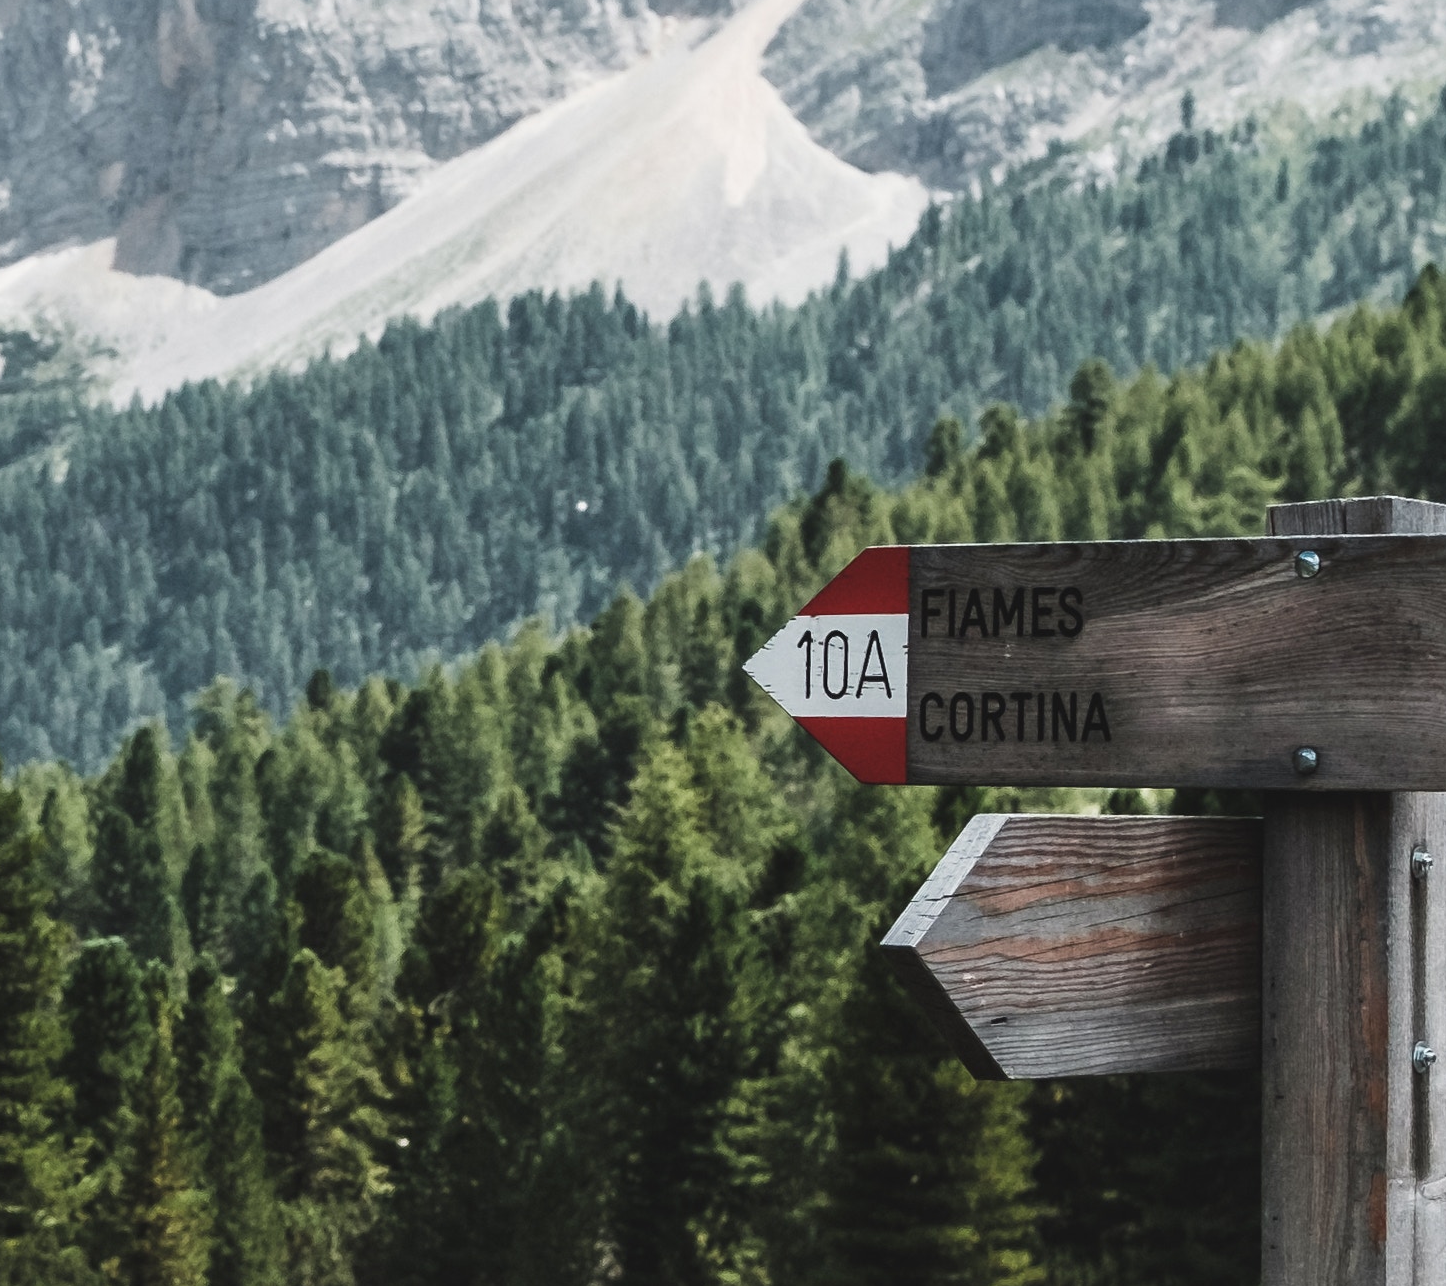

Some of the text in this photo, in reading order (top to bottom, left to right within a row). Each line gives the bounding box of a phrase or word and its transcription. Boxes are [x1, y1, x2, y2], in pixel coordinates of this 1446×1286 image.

[921, 586, 1085, 639] FIAMES
[797, 629, 893, 699] 10A
[920, 691, 1113, 743] CORTINA
